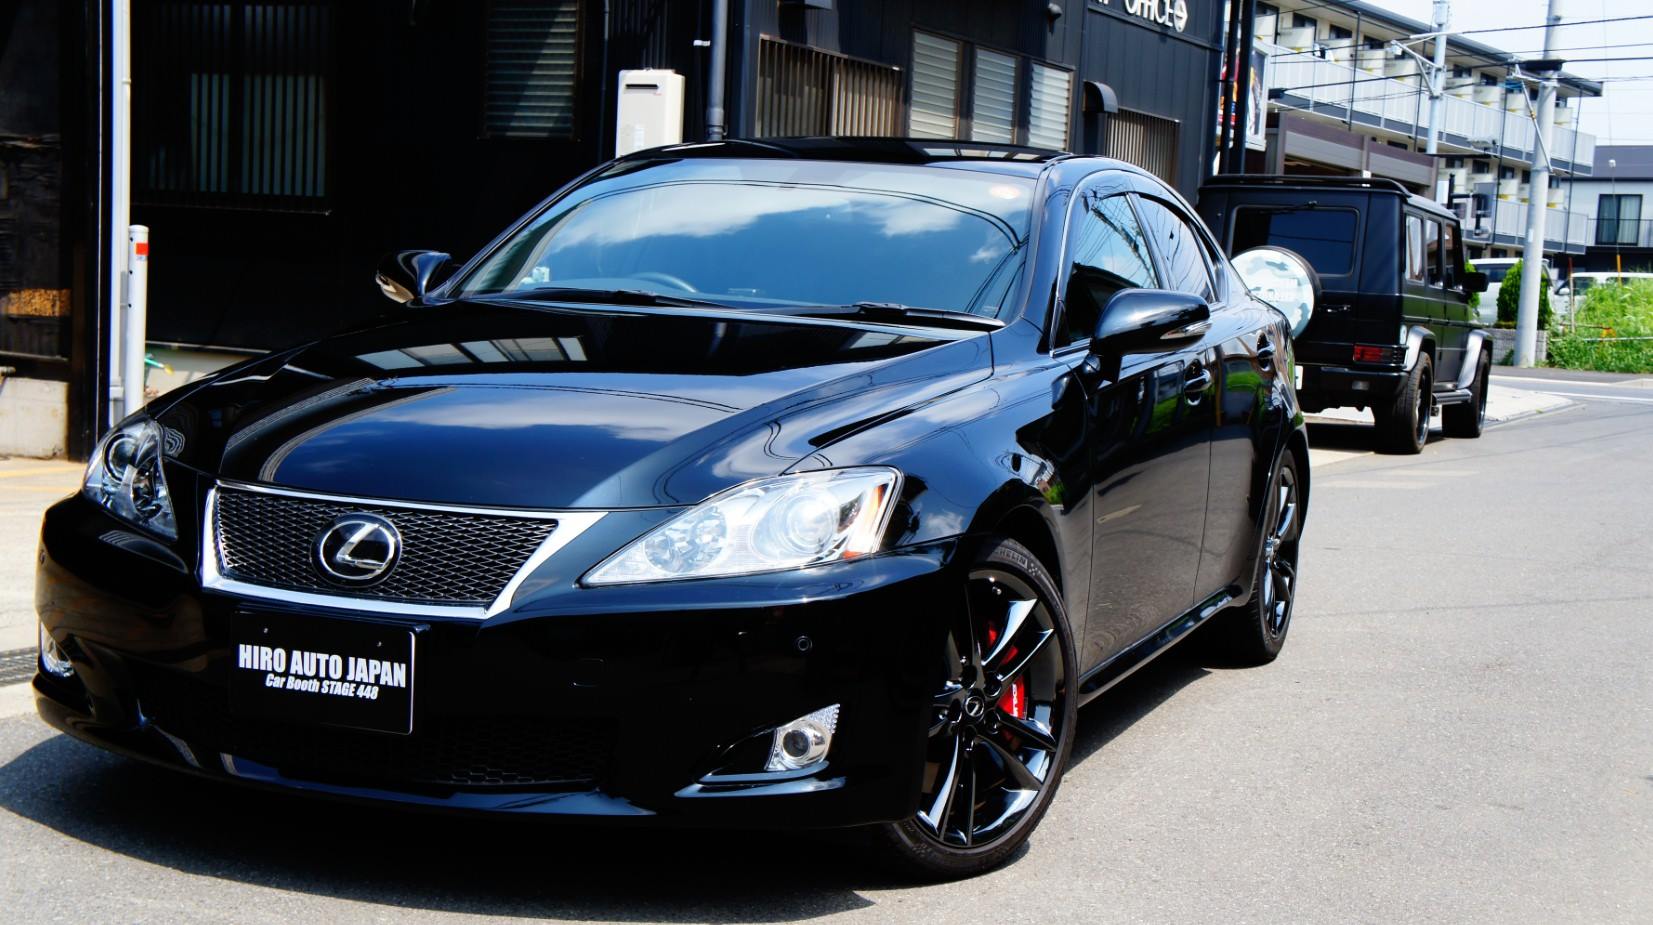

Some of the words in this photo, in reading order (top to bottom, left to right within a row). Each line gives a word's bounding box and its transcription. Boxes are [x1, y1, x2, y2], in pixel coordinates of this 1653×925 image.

[238, 643, 287, 673] HIRO
[289, 650, 343, 680] AUTO
[346, 657, 407, 688] JAPAN
[265, 673, 286, 688] Car
[286, 676, 320, 693] Booth
[320, 680, 356, 697] STAGE
[356, 685, 380, 700] 448
